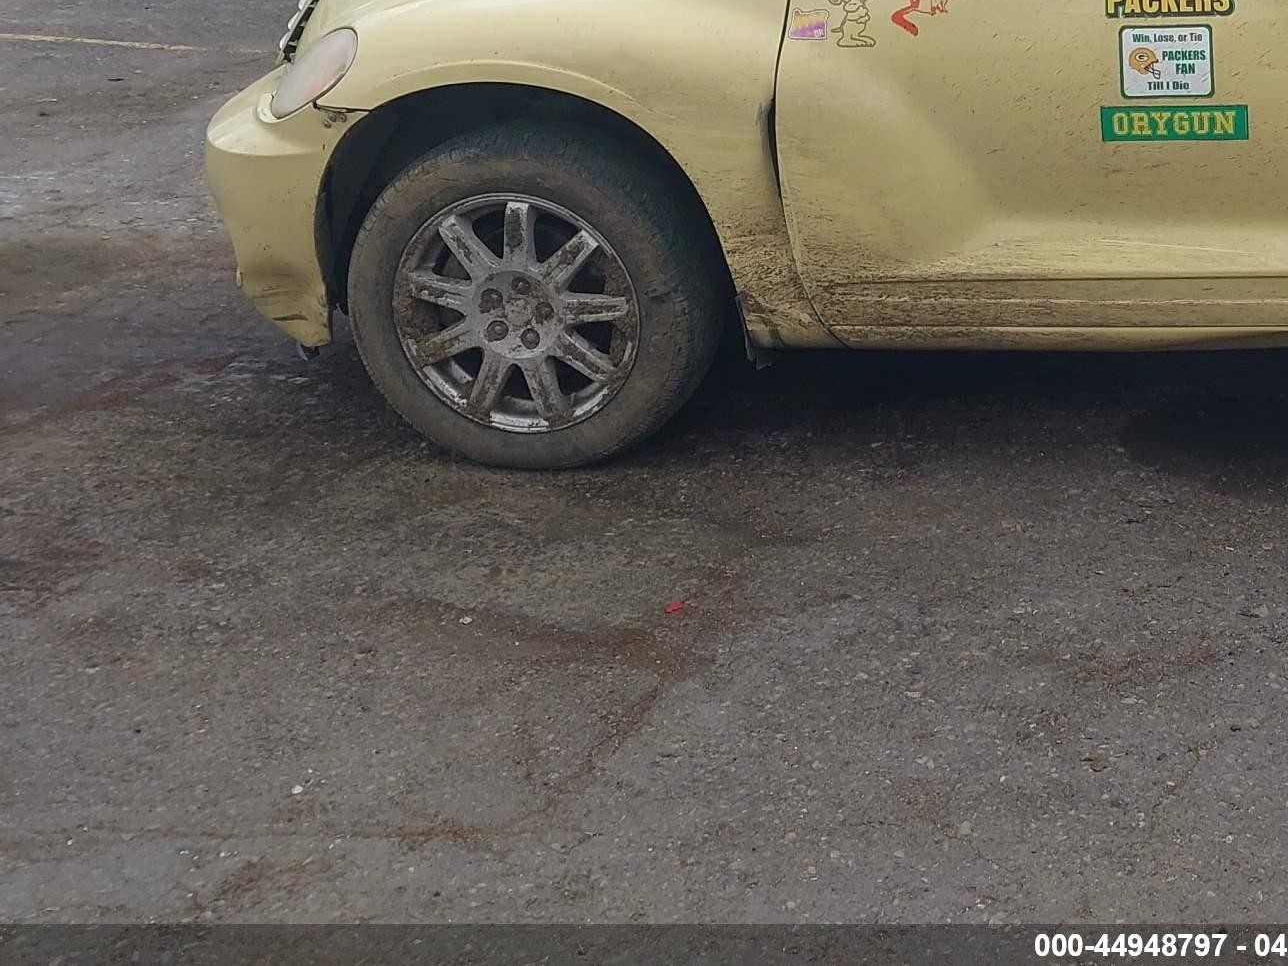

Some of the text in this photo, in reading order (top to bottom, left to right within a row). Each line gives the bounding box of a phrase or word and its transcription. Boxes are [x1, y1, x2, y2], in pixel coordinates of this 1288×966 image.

[1132, 32, 1203, 43] Win, Lose, or Tie
[1162, 50, 1206, 61] PACKERS
[1175, 63, 1196, 75] FAN
[1147, 81, 1164, 91] Till
[1172, 81, 1190, 90] Die
[1111, 111, 1237, 136] ORYGUN
